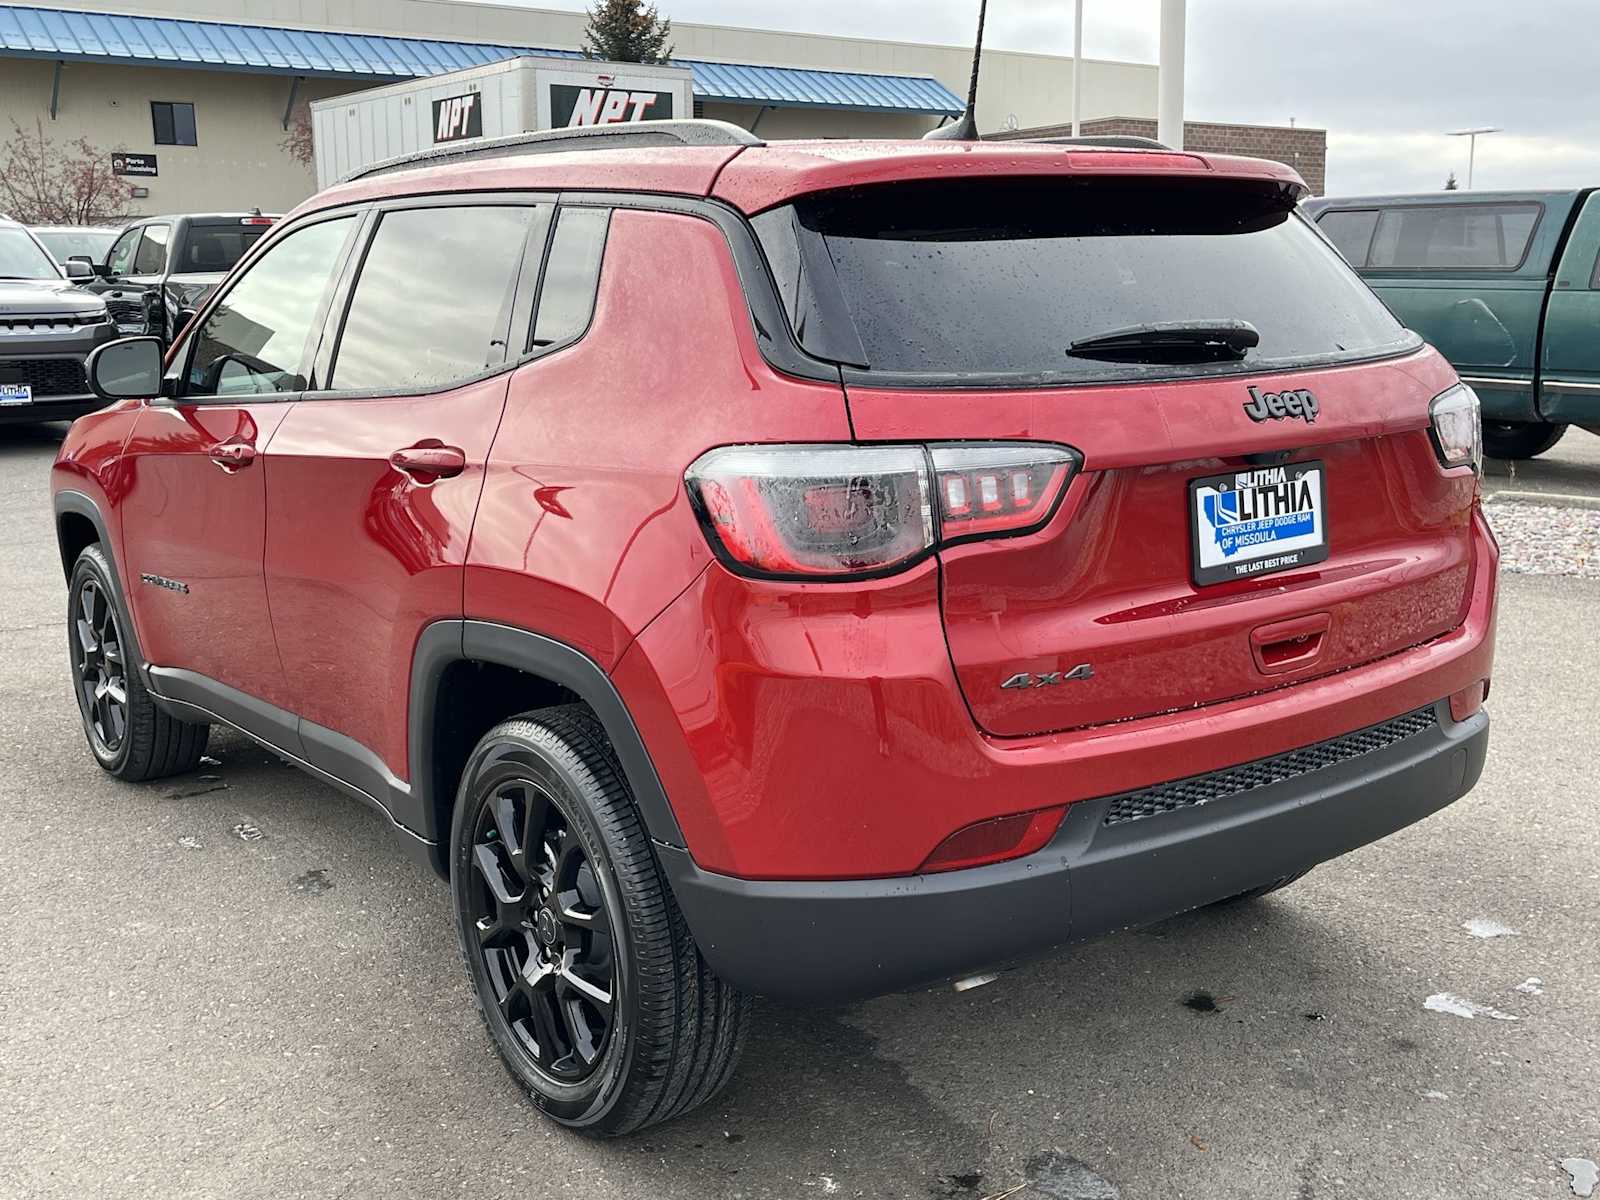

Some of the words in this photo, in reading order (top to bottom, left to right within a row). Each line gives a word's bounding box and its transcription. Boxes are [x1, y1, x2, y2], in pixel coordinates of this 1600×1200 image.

[436, 95, 474, 140] NPT
[567, 88, 657, 129] NPT
[1243, 386, 1319, 423] Jeep
[1247, 467, 1287, 487] LITHIA
[1239, 480, 1313, 520] LITHIA
[1221, 523, 1257, 536] CHRYSLER
[1257, 519, 1274, 531] JEEP
[1274, 515, 1297, 528] DODGE
[1297, 512, 1311, 524] RAM
[1221, 536, 1234, 549] OF
[1235, 530, 1277, 546] MISSOULA
[1235, 564, 1249, 574] THE
[1248, 560, 1264, 572] LAST
[1264, 557, 1279, 569] BEST
[1280, 554, 1299, 566] PRICE
